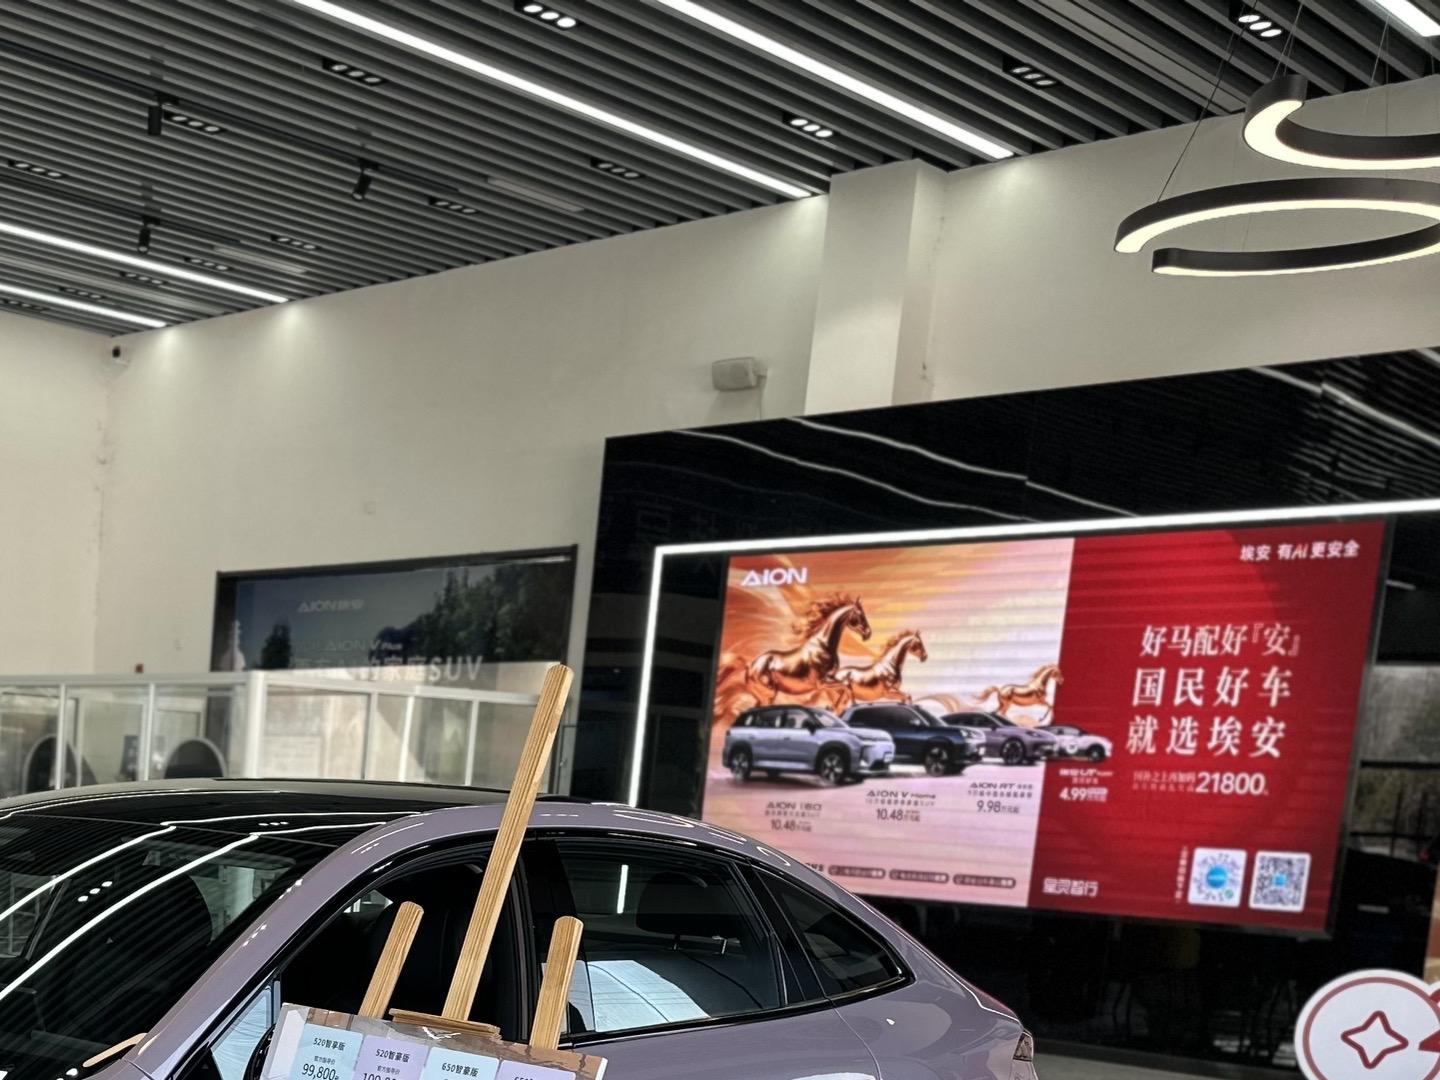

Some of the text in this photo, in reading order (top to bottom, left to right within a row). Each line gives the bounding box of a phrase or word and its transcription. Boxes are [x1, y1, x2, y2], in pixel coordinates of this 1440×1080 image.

[741, 567, 808, 586] AION
[1132, 665, 1293, 707] 国民好车
[1126, 714, 1287, 758] 就选埃安
[866, 790, 897, 799] AION
